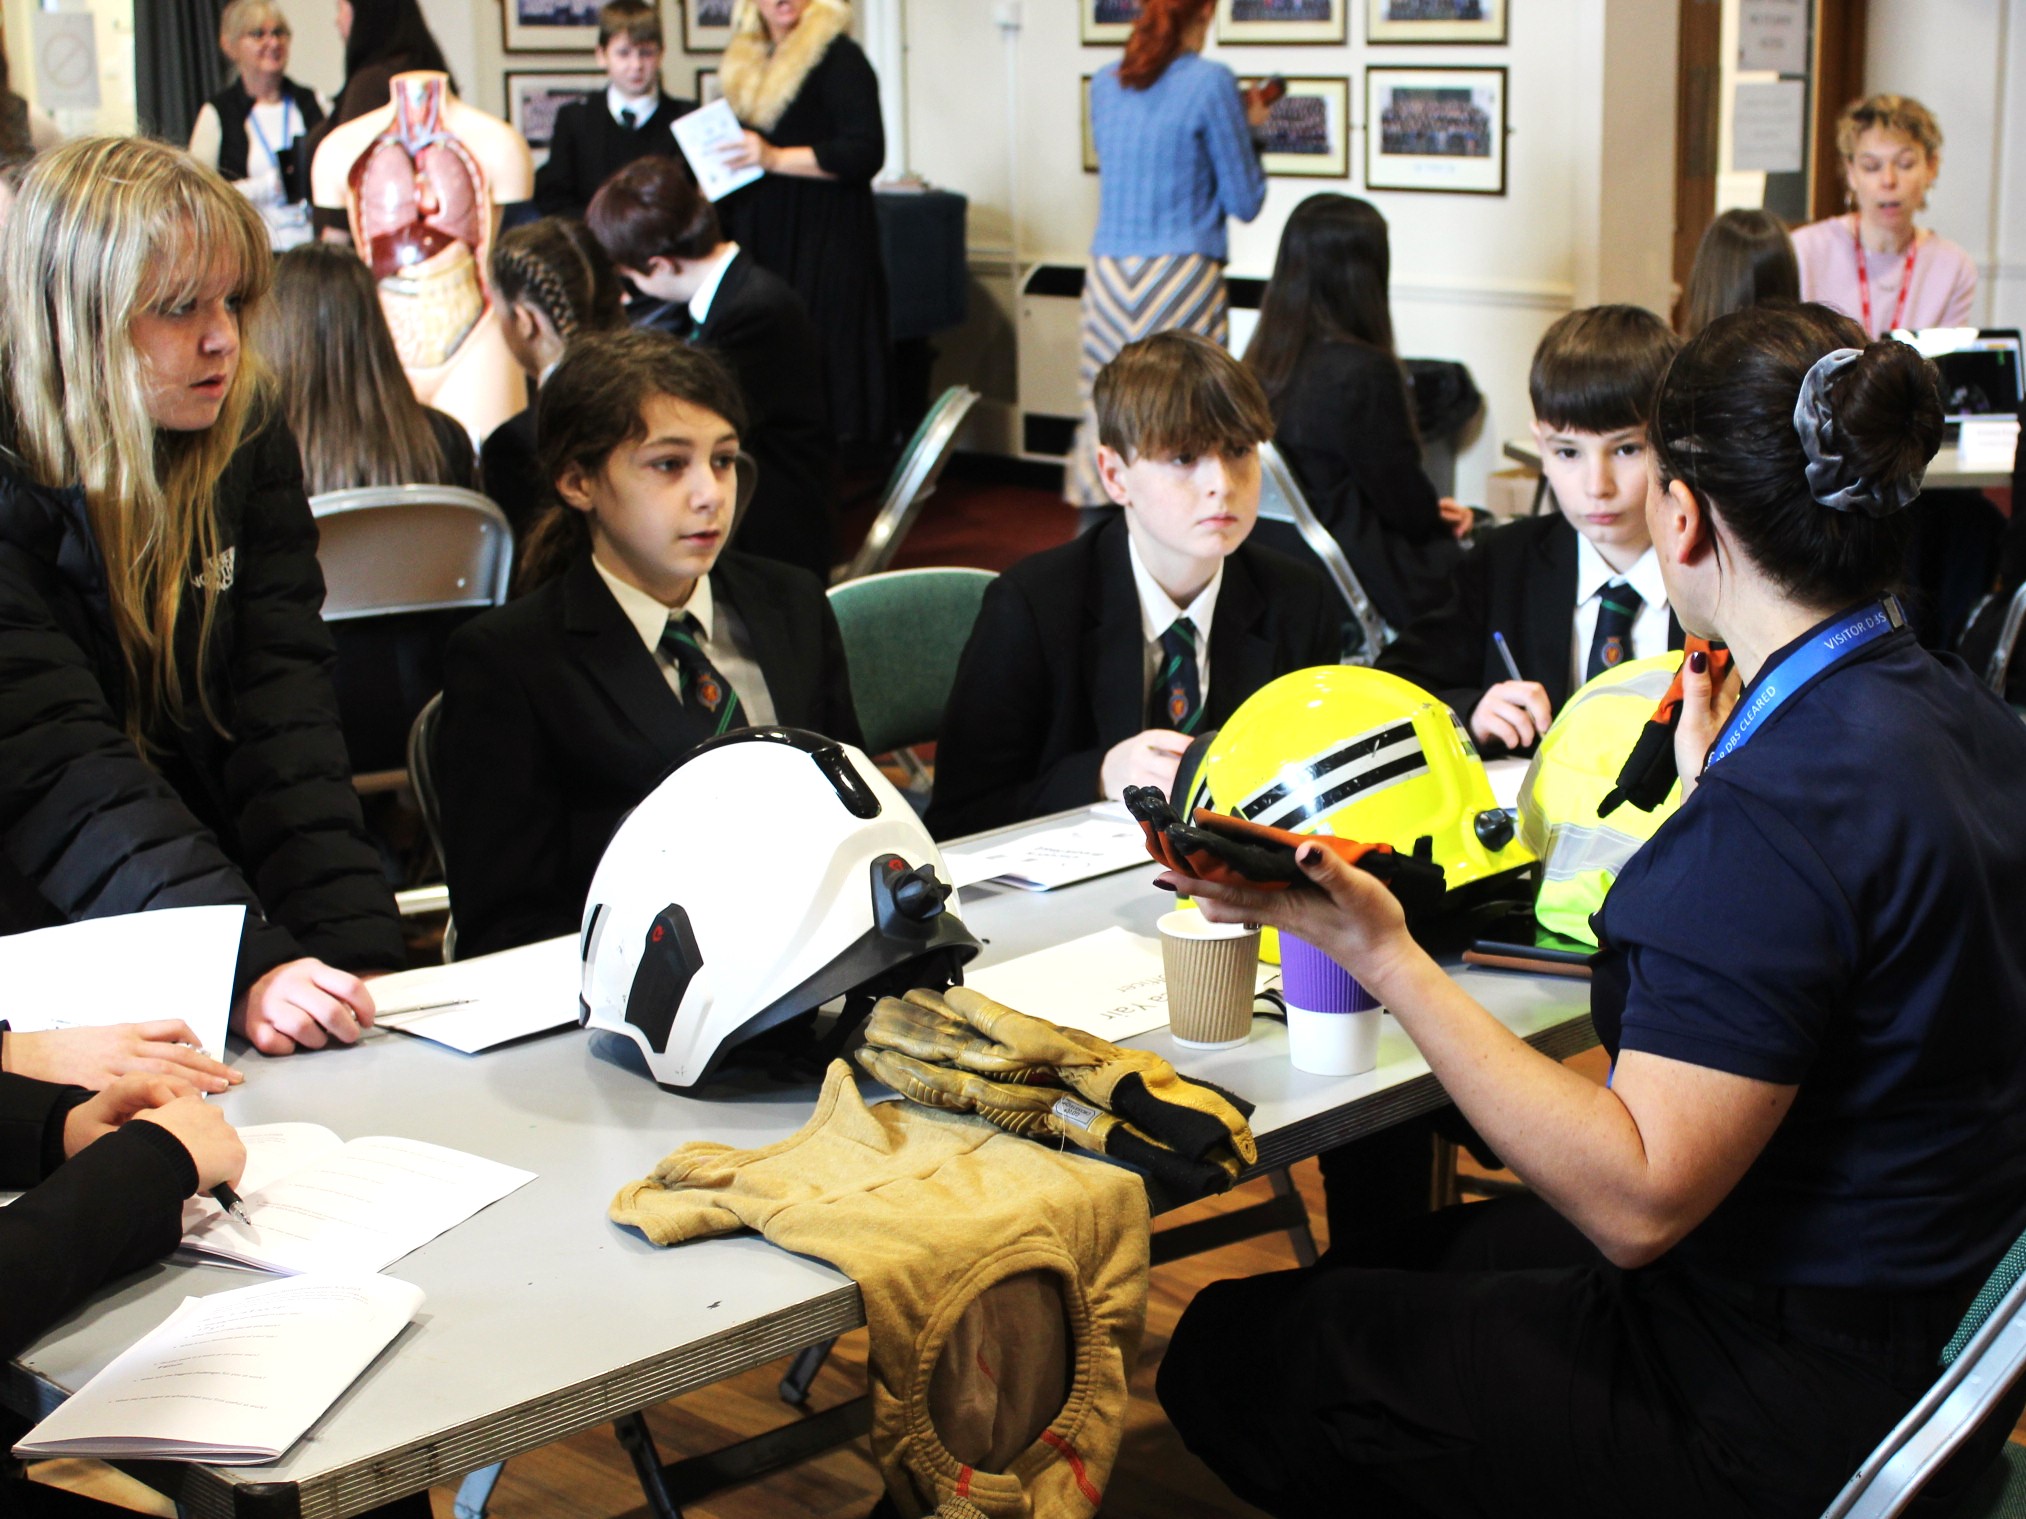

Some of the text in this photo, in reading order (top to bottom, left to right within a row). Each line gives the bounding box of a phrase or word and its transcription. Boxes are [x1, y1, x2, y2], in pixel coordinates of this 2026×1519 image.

[1823, 622, 1867, 650] VISITOR
[1725, 685, 1777, 753] DBS CLEARED
[1100, 1002, 1158, 1020] Yair
